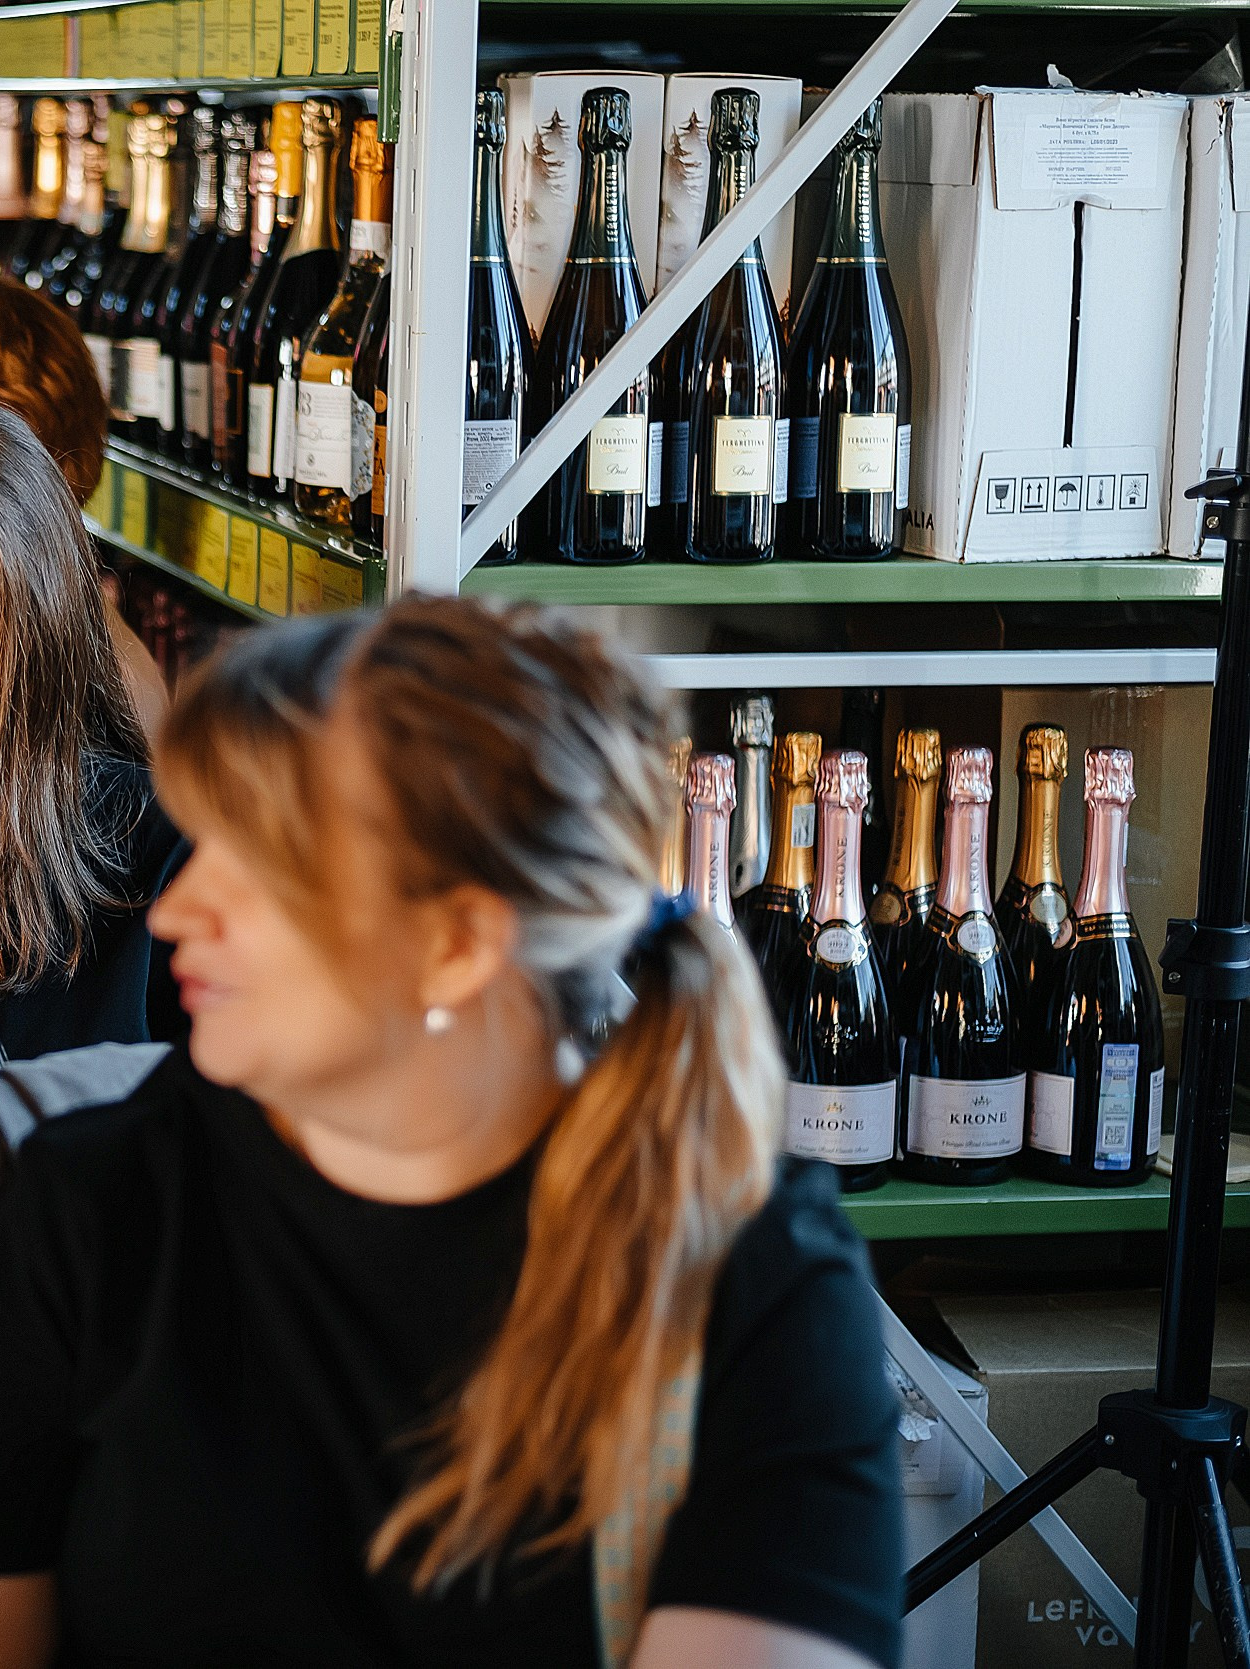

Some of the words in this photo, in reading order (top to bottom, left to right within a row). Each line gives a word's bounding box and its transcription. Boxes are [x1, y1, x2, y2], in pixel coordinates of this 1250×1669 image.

[836, 837, 847, 899] KRONE
[969, 833, 980, 895] KRONE
[803, 1118, 864, 1131] KRONE
[950, 1110, 1007, 1125] KRONE
